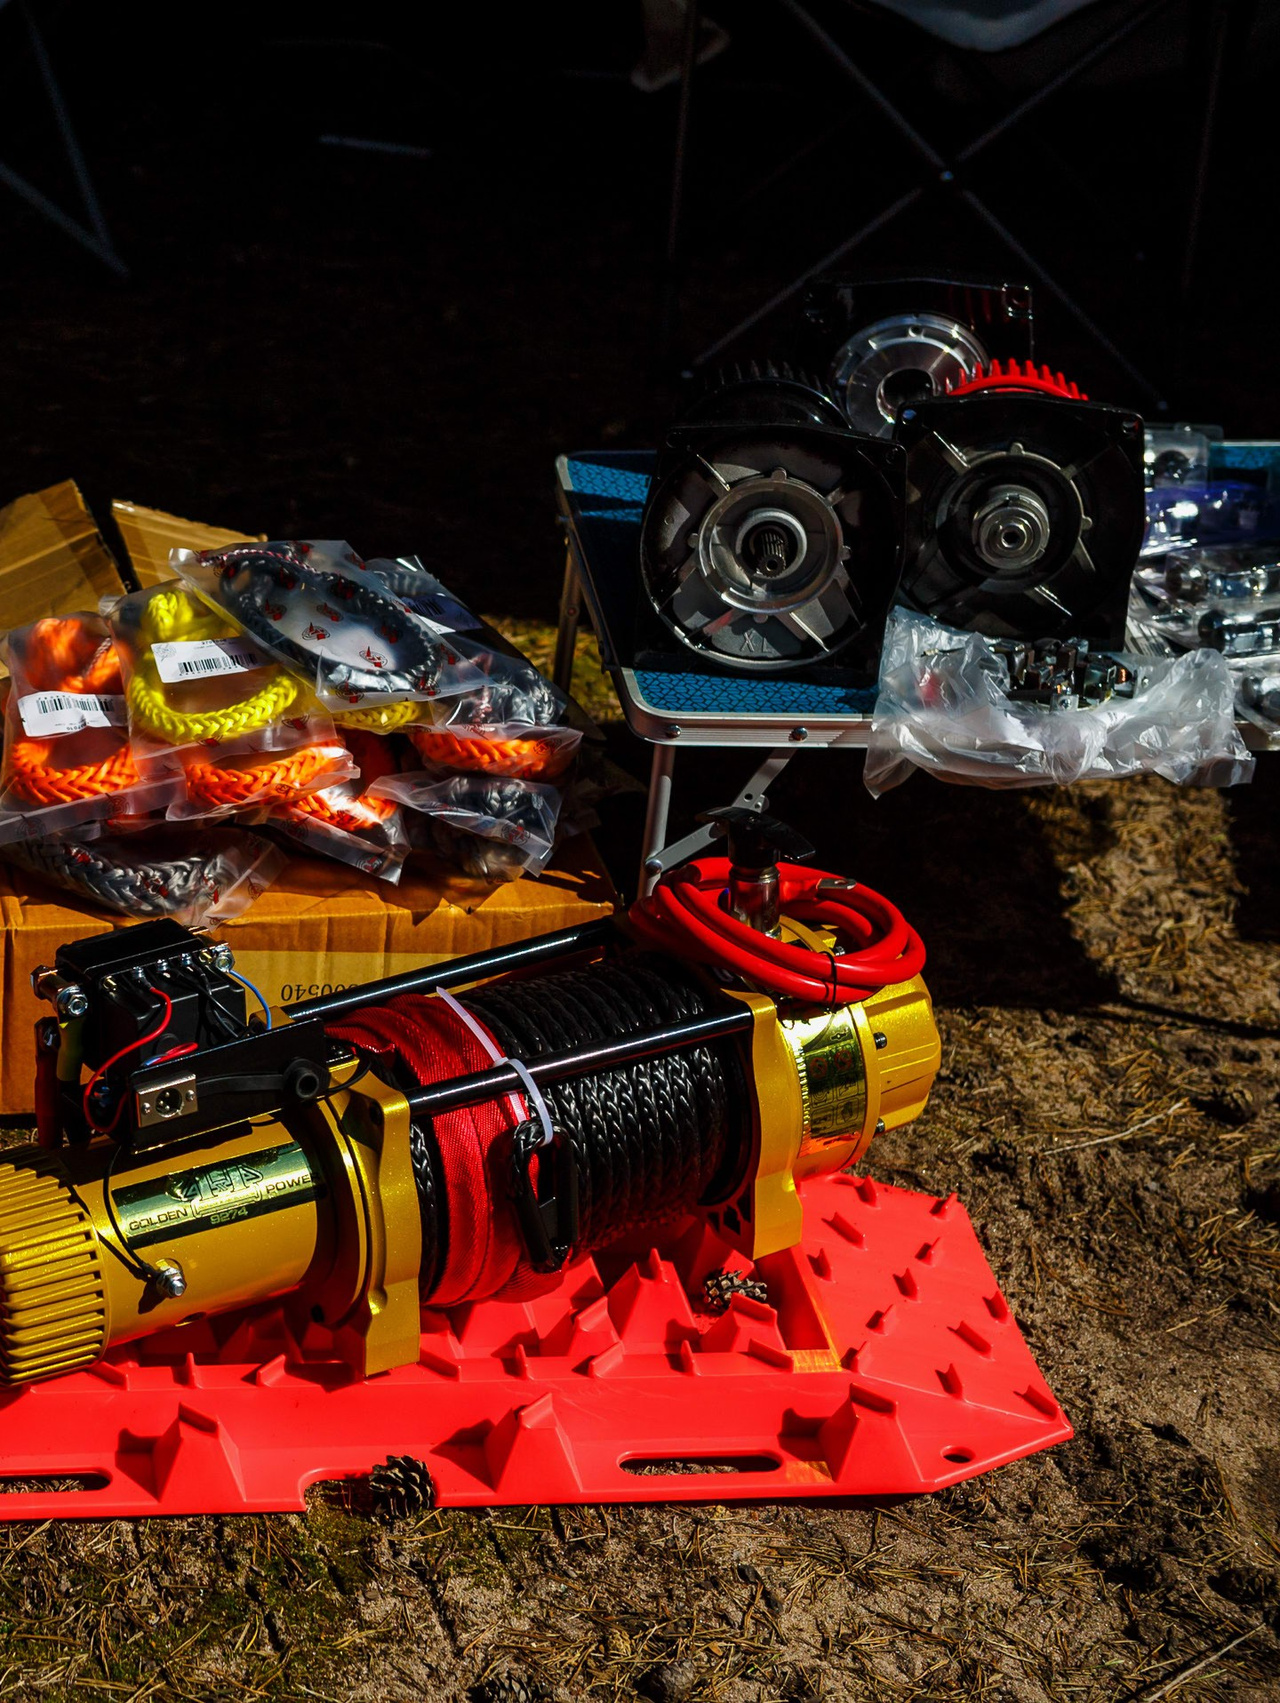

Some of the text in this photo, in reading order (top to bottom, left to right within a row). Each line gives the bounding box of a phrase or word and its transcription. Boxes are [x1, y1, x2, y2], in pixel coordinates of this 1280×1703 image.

[739, 631, 774, 654] XL
[281, 983, 358, 1001] 0540
[129, 1208, 188, 1232] GOLDEN
[210, 1206, 249, 1224] 9274
